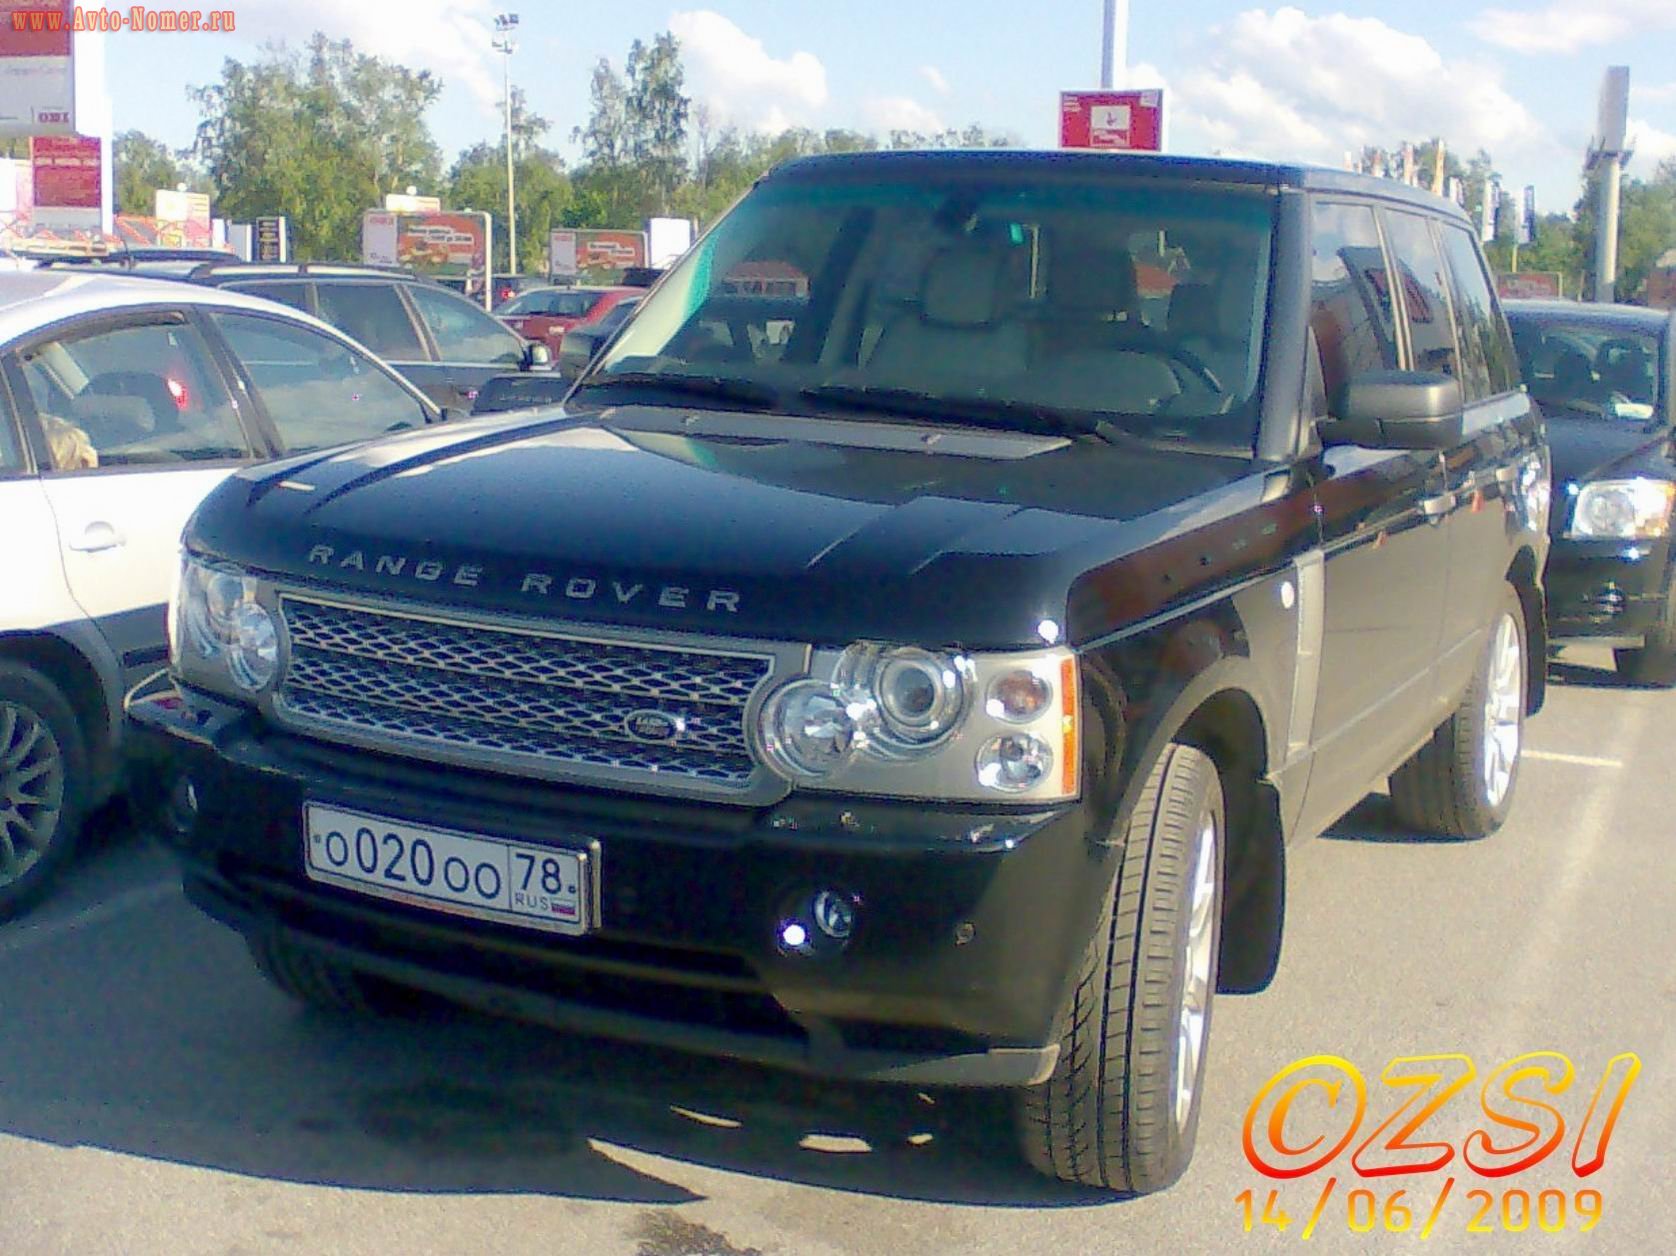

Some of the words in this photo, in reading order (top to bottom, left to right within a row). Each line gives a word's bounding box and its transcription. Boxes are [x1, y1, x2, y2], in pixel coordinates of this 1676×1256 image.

[309, 544, 483, 586] RANGE
[521, 573, 740, 612] ROVER
[515, 853, 562, 895] 78
[514, 892, 549, 911] RUS
